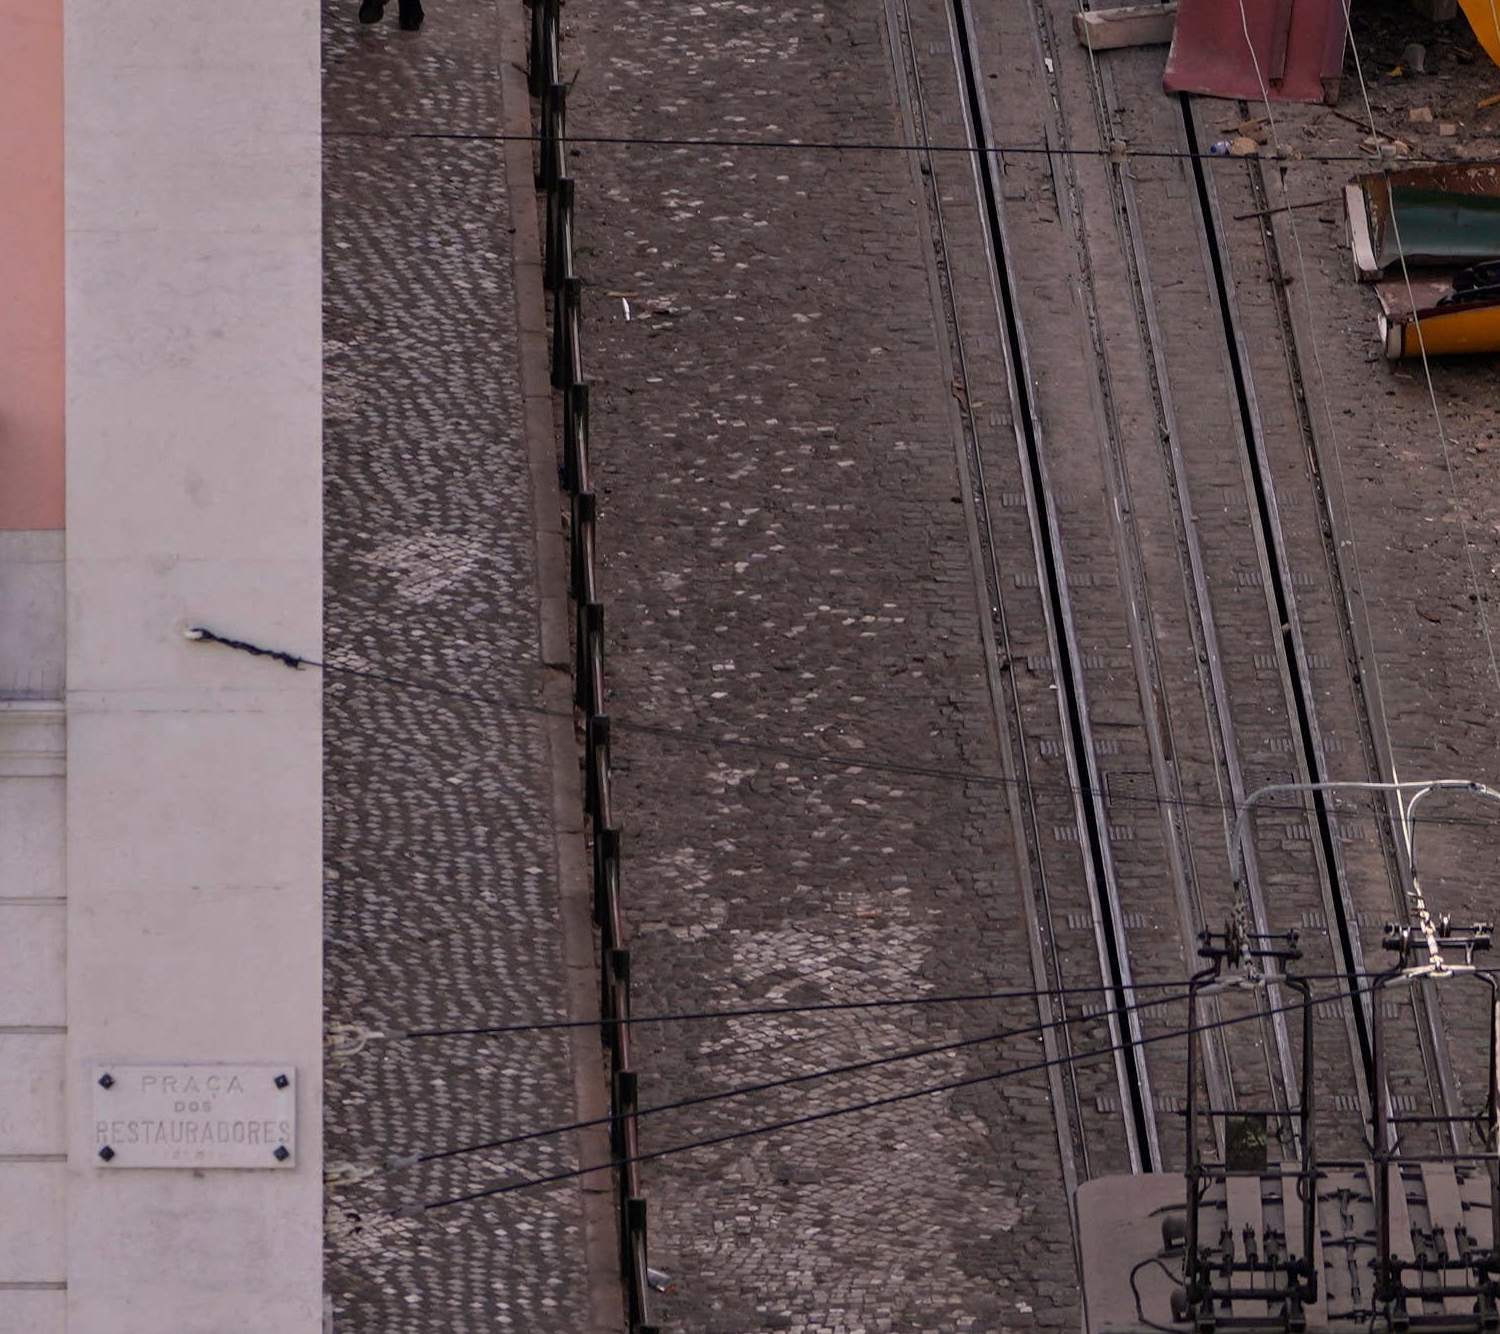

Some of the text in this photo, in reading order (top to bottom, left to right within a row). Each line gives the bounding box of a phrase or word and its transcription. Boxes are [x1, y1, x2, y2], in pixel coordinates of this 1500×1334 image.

[141, 1075, 244, 1099] PRAÇA
[174, 1100, 212, 1113] DOS
[96, 1120, 291, 1145] RESTAURADORES
